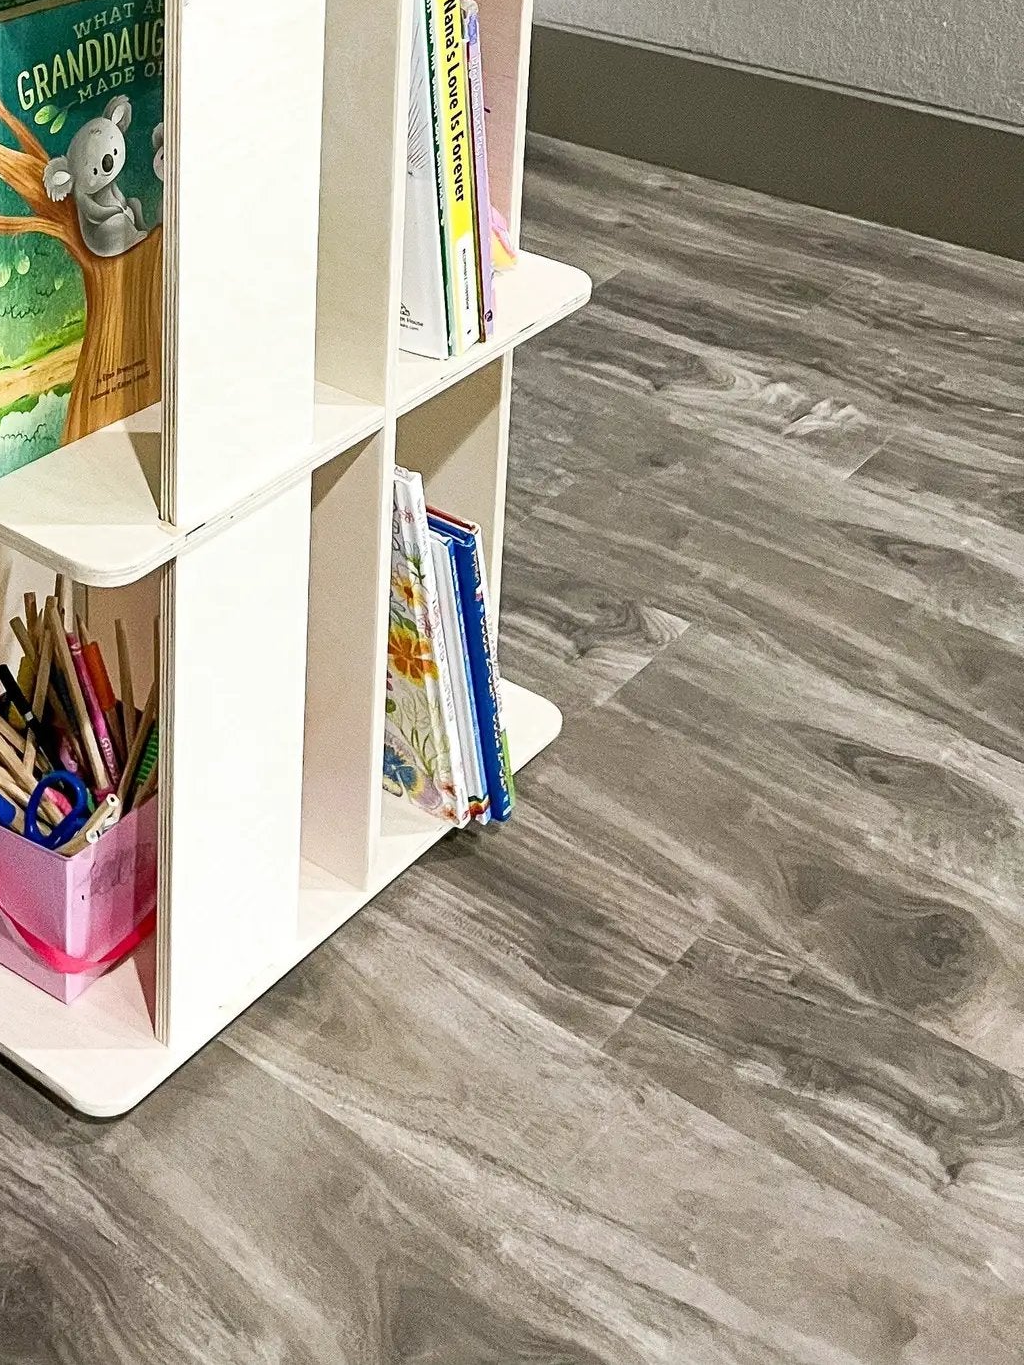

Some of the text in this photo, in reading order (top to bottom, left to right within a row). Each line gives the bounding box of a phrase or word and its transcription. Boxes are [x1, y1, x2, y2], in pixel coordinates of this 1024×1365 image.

[72, 2, 135, 39] WHAT
[77, 66, 136, 104] MADE
[447, 62, 460, 110] Love
[450, 110, 462, 132] Is
[452, 130, 464, 202] Forever
